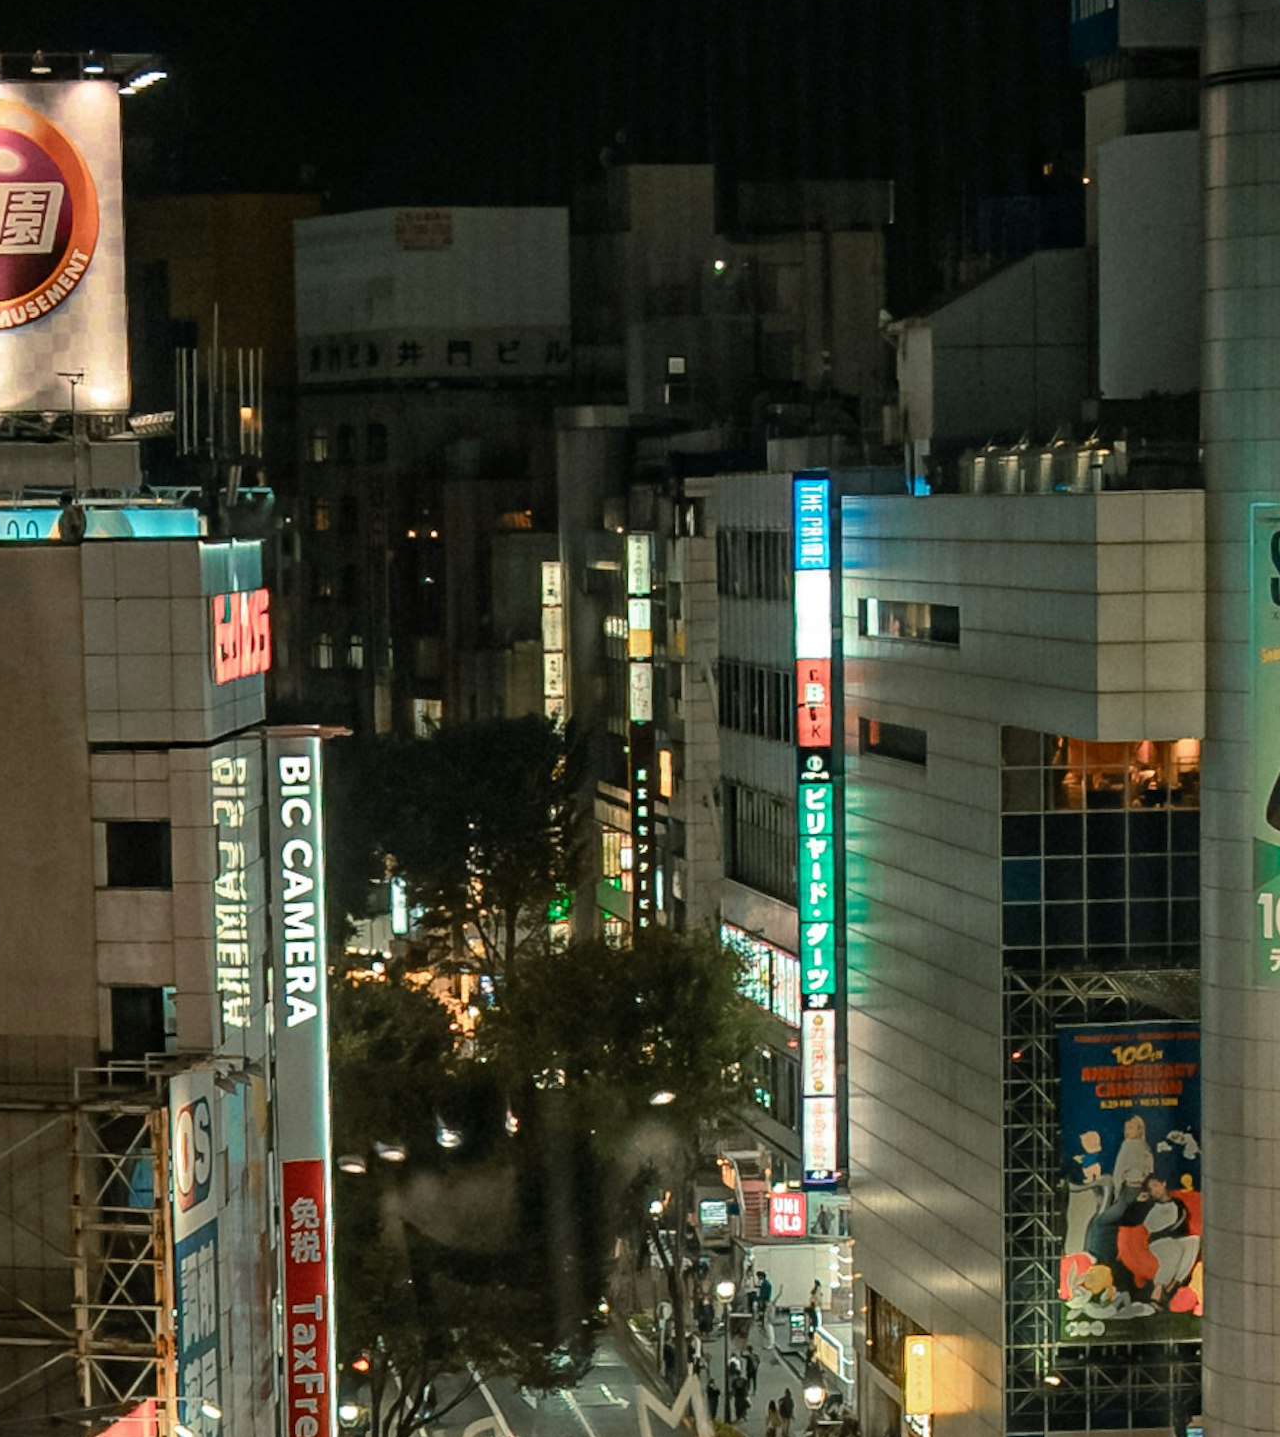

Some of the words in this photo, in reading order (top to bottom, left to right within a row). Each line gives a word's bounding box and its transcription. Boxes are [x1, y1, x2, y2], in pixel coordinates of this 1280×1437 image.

[279, 755, 312, 830] BIC
[280, 839, 318, 1029] CAMERA
[803, 787, 830, 992] ビリヤード・ダーツ
[177, 1105, 211, 1204] OS
[289, 1196, 323, 1265] 免税
